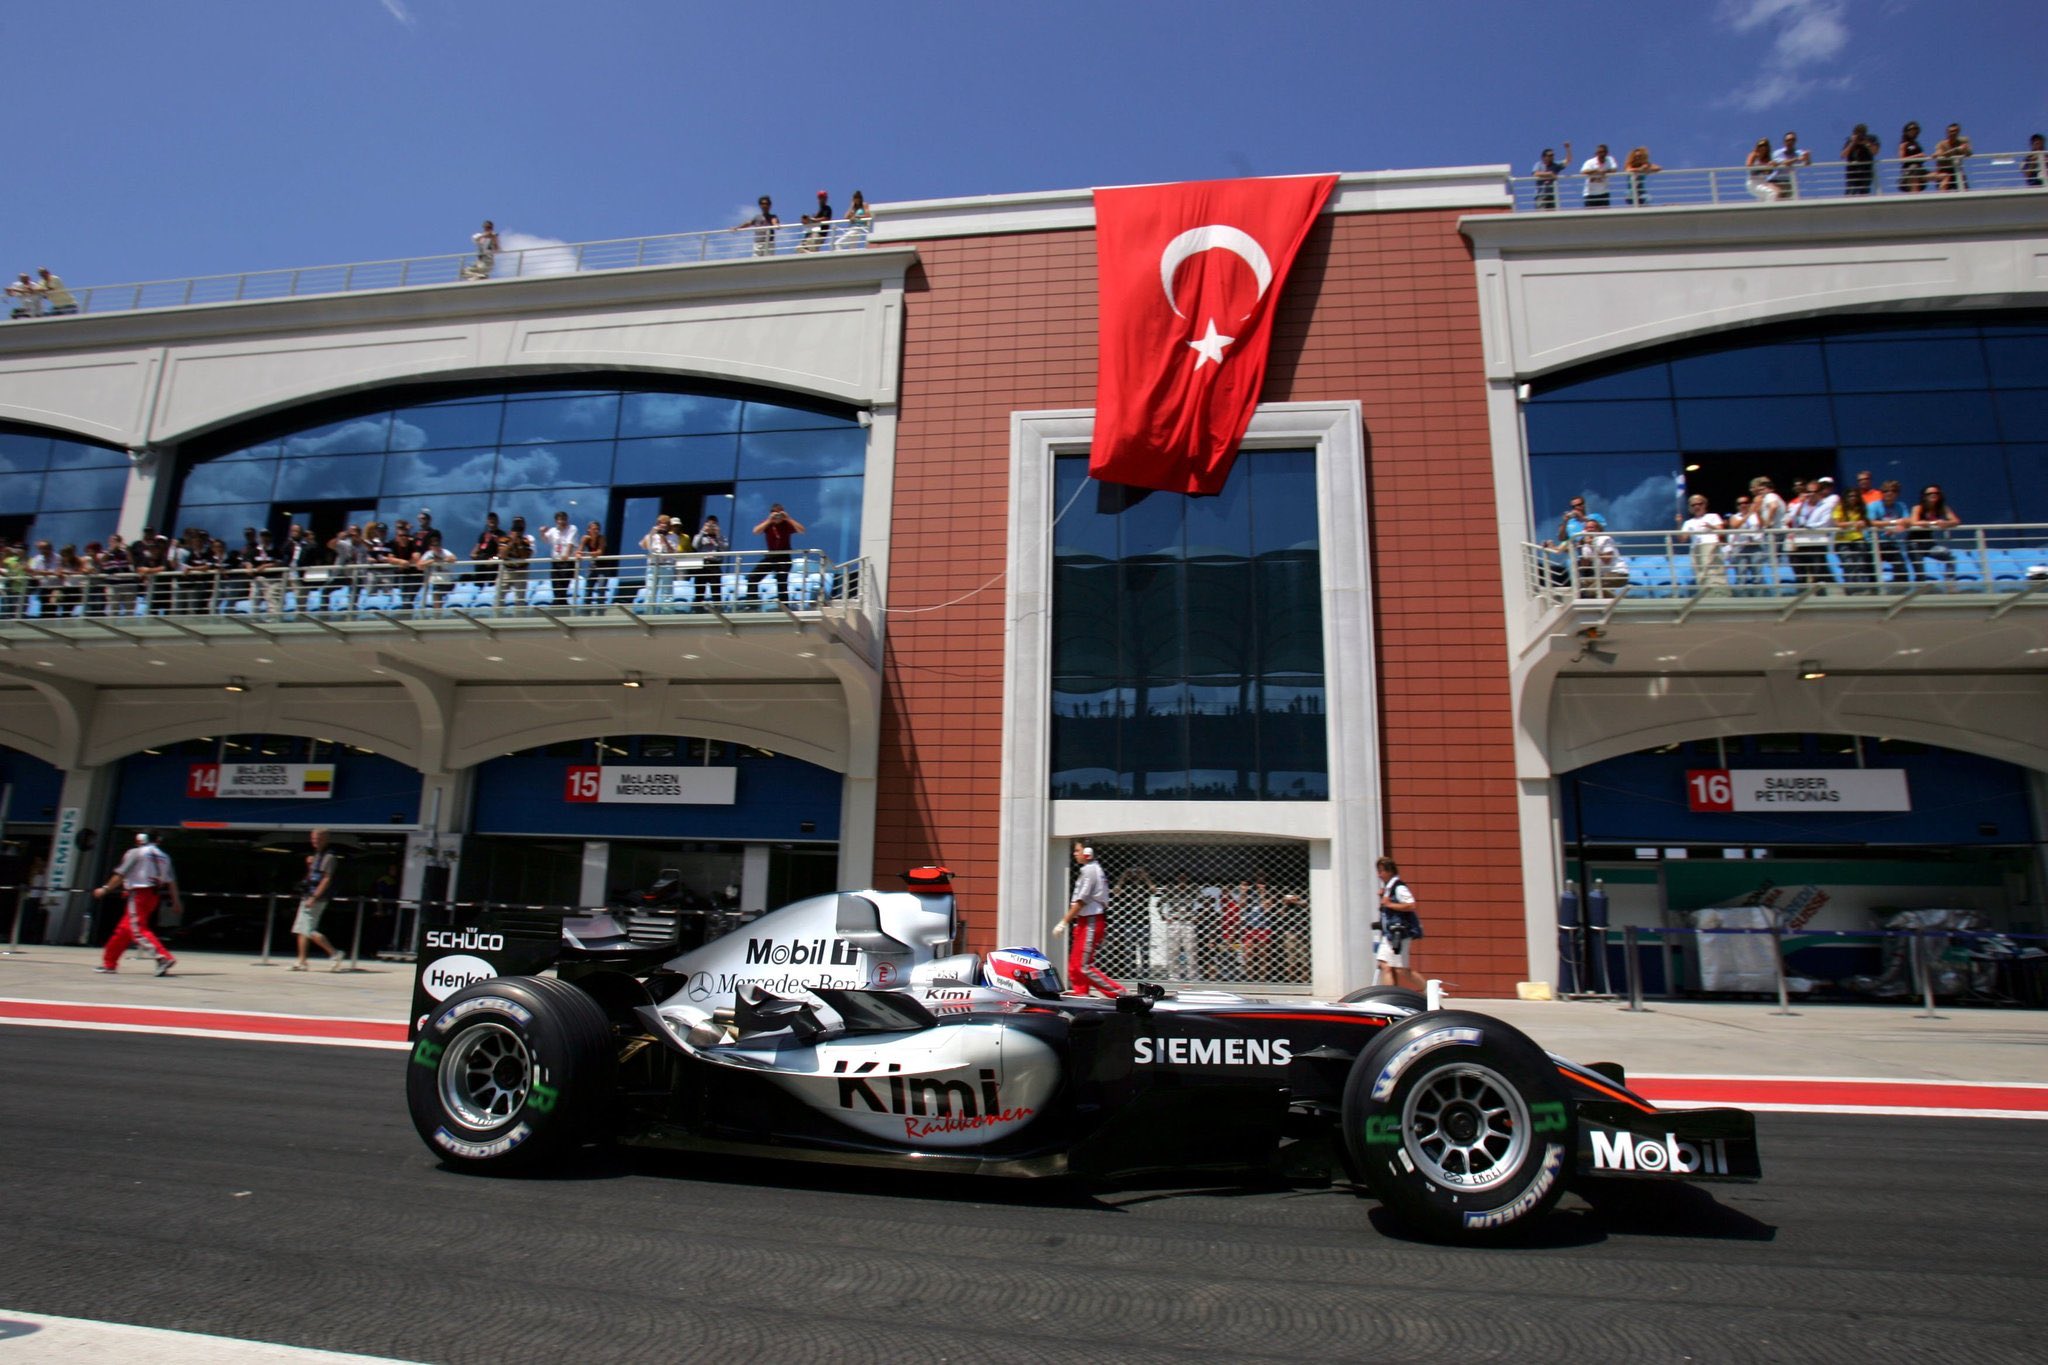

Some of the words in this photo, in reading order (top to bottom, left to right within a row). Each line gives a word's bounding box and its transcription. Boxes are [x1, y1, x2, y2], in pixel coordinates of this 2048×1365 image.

[192, 769, 217, 792] 14
[232, 776, 289, 785] MERCEDES
[570, 771, 599, 797] 15
[616, 785, 682, 795] MERCEDES
[620, 774, 679, 784] McLAREN
[1691, 775, 1730, 804] 16
[1764, 778, 1828, 789] SAUBER
[1755, 790, 1840, 802] PETRONAS
[426, 927, 504, 951] SCHÜCO
[745, 938, 827, 965] Mobil
[925, 989, 972, 1000] Kimi
[1134, 1036, 1292, 1066] SIEMENS
[834, 1060, 1001, 1119] Kimi
[1589, 1130, 1729, 1175] Mobil
[1467, 1175, 1554, 1228] MICHELIN
